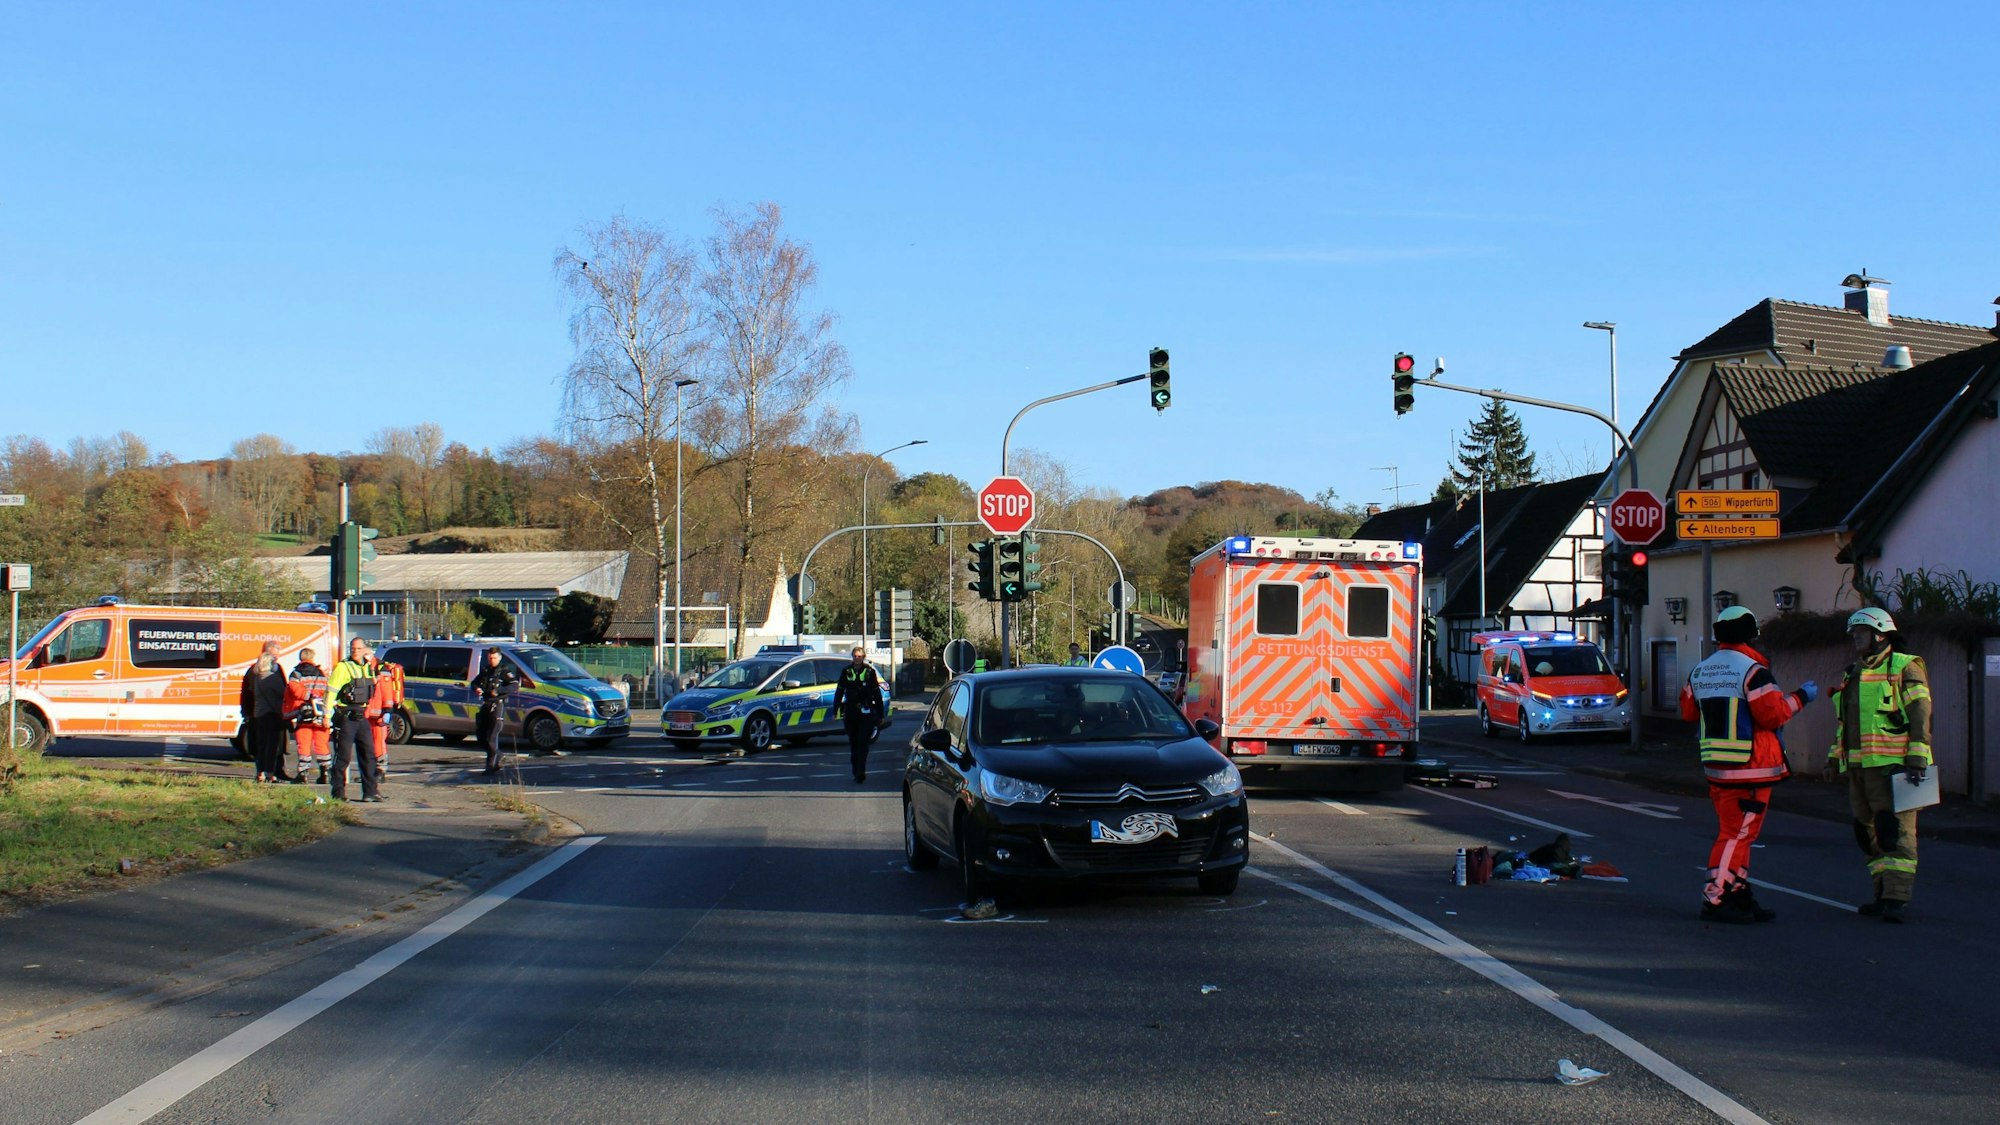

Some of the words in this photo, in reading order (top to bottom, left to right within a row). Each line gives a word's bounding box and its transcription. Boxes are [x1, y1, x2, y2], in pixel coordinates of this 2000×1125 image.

[983, 494, 1029, 516] STOP
[1703, 498, 1719, 506] 506
[1725, 497, 1774, 508] Wipperfürth
[1614, 505, 1660, 528] STOP
[1702, 524, 1756, 535] Altenberg
[138, 630, 195, 640] FEUERWEHR
[196, 631, 240, 641] BERGISCH
[242, 633, 291, 642] GLADBACH
[138, 641, 217, 652] EINSATZLEITUNG
[1257, 643, 1387, 658] RETTUNGSDIENST
[1699, 680, 1738, 691] Rettungsdienst
[785, 699, 811, 708] POLIZEI
[1272, 702, 1294, 713] 112
[1312, 745, 1322, 754] FW
[1322, 745, 1340, 754] 2042
